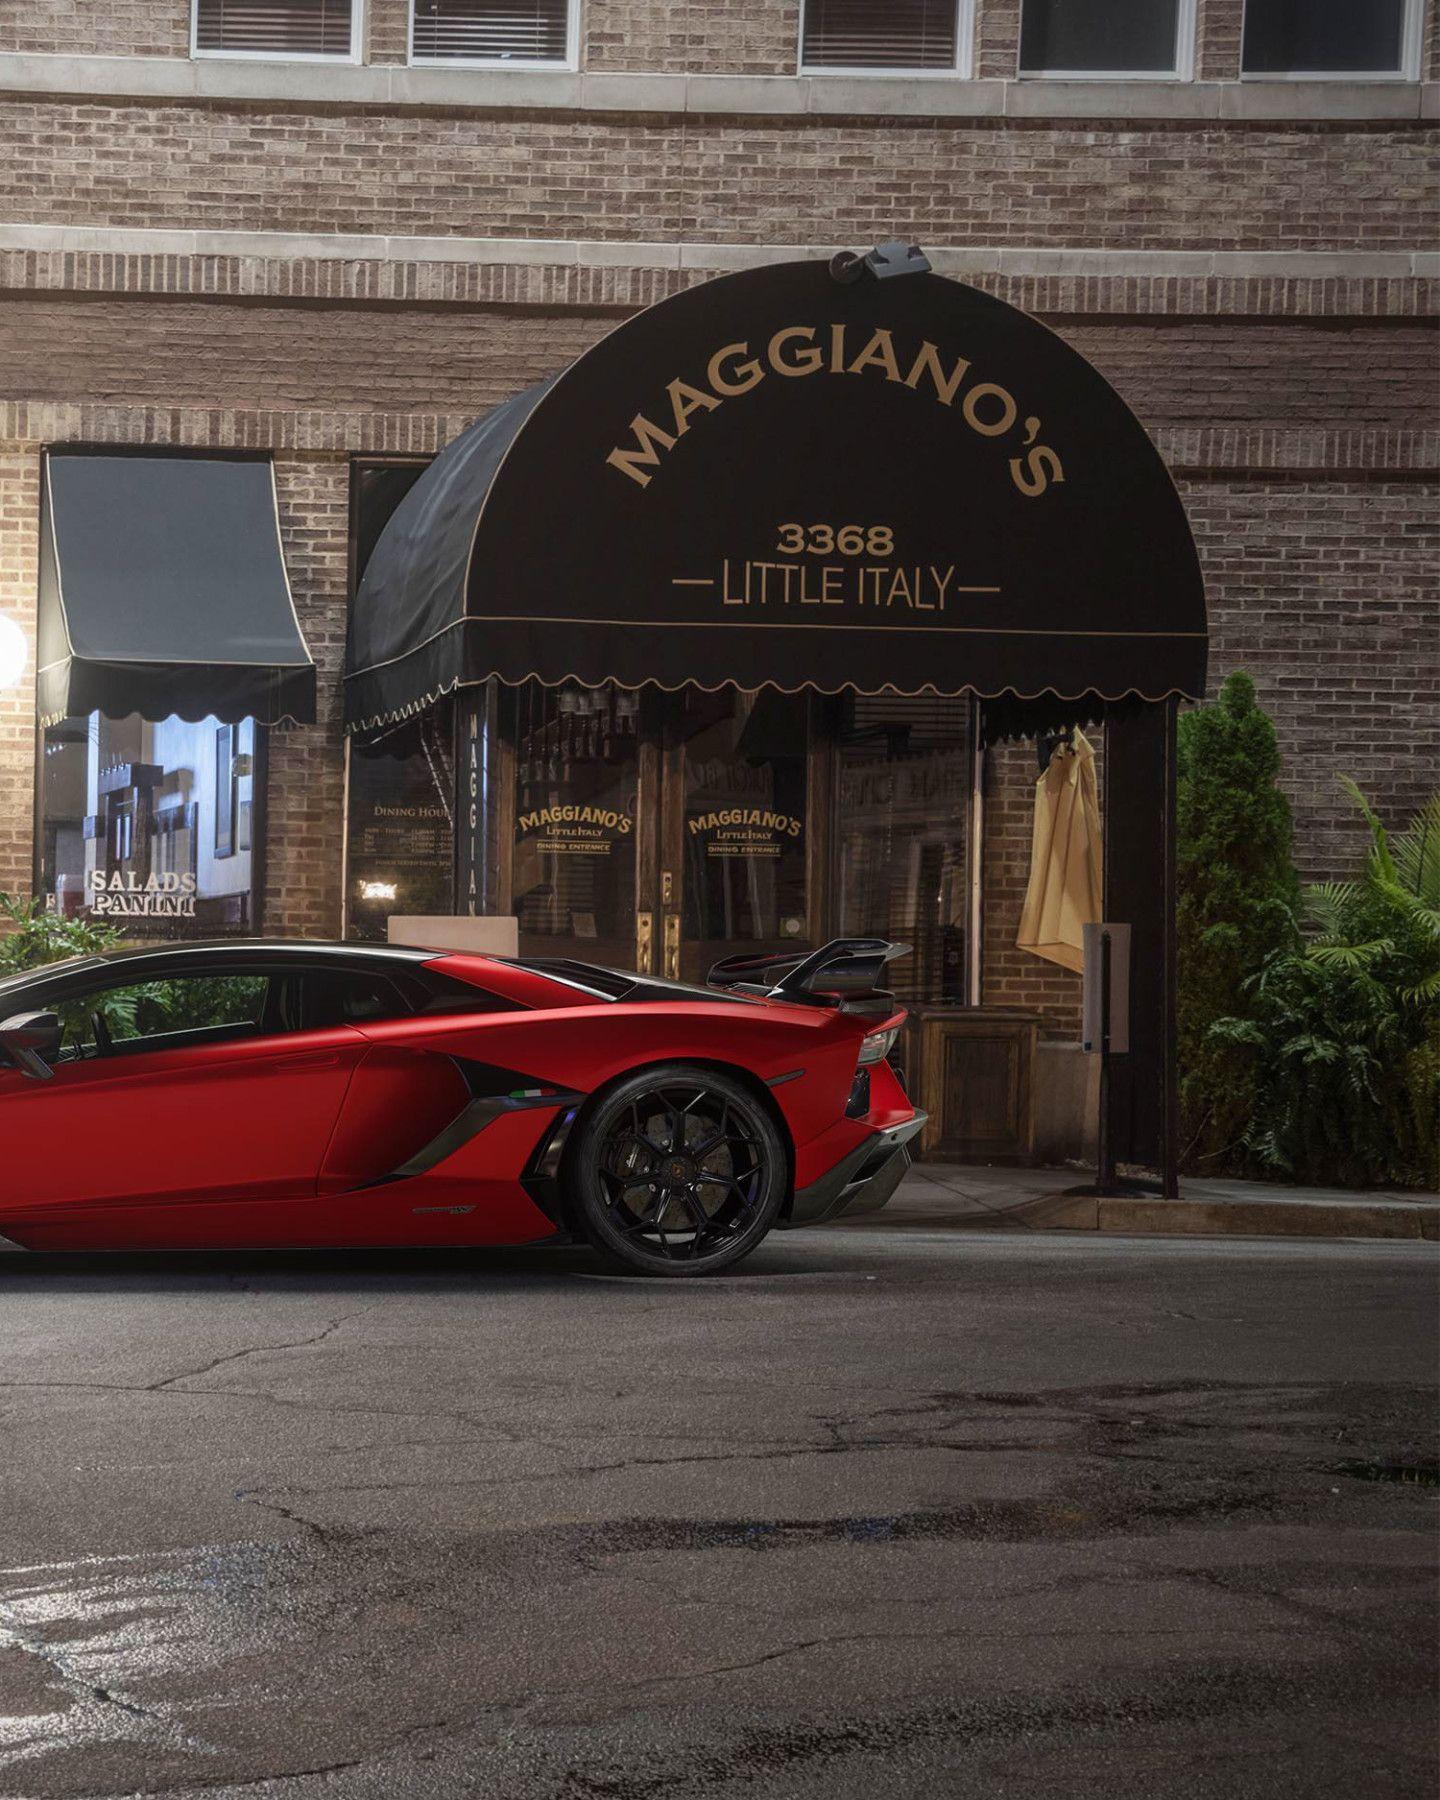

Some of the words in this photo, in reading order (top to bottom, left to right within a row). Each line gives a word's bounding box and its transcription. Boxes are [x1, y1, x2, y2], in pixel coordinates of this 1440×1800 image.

[606, 323, 1065, 497] MAGGIANO'S
[776, 523, 895, 556] 3368
[723, 558, 845, 605] LITTLE
[858, 564, 955, 610] ITALY
[374, 806, 416, 816] DINING
[519, 805, 632, 833] MAGGIANO'S
[688, 809, 801, 837] MAGGIANO'S
[546, 825, 577, 835] LITTLE
[578, 826, 603, 837] ITALY
[717, 829, 747, 839] LITTLE
[748, 830, 772, 840] ITALY
[568, 843, 610, 851] ENTRANCE
[91, 869, 196, 893] SALADS
[90, 893, 196, 917] PANINI
